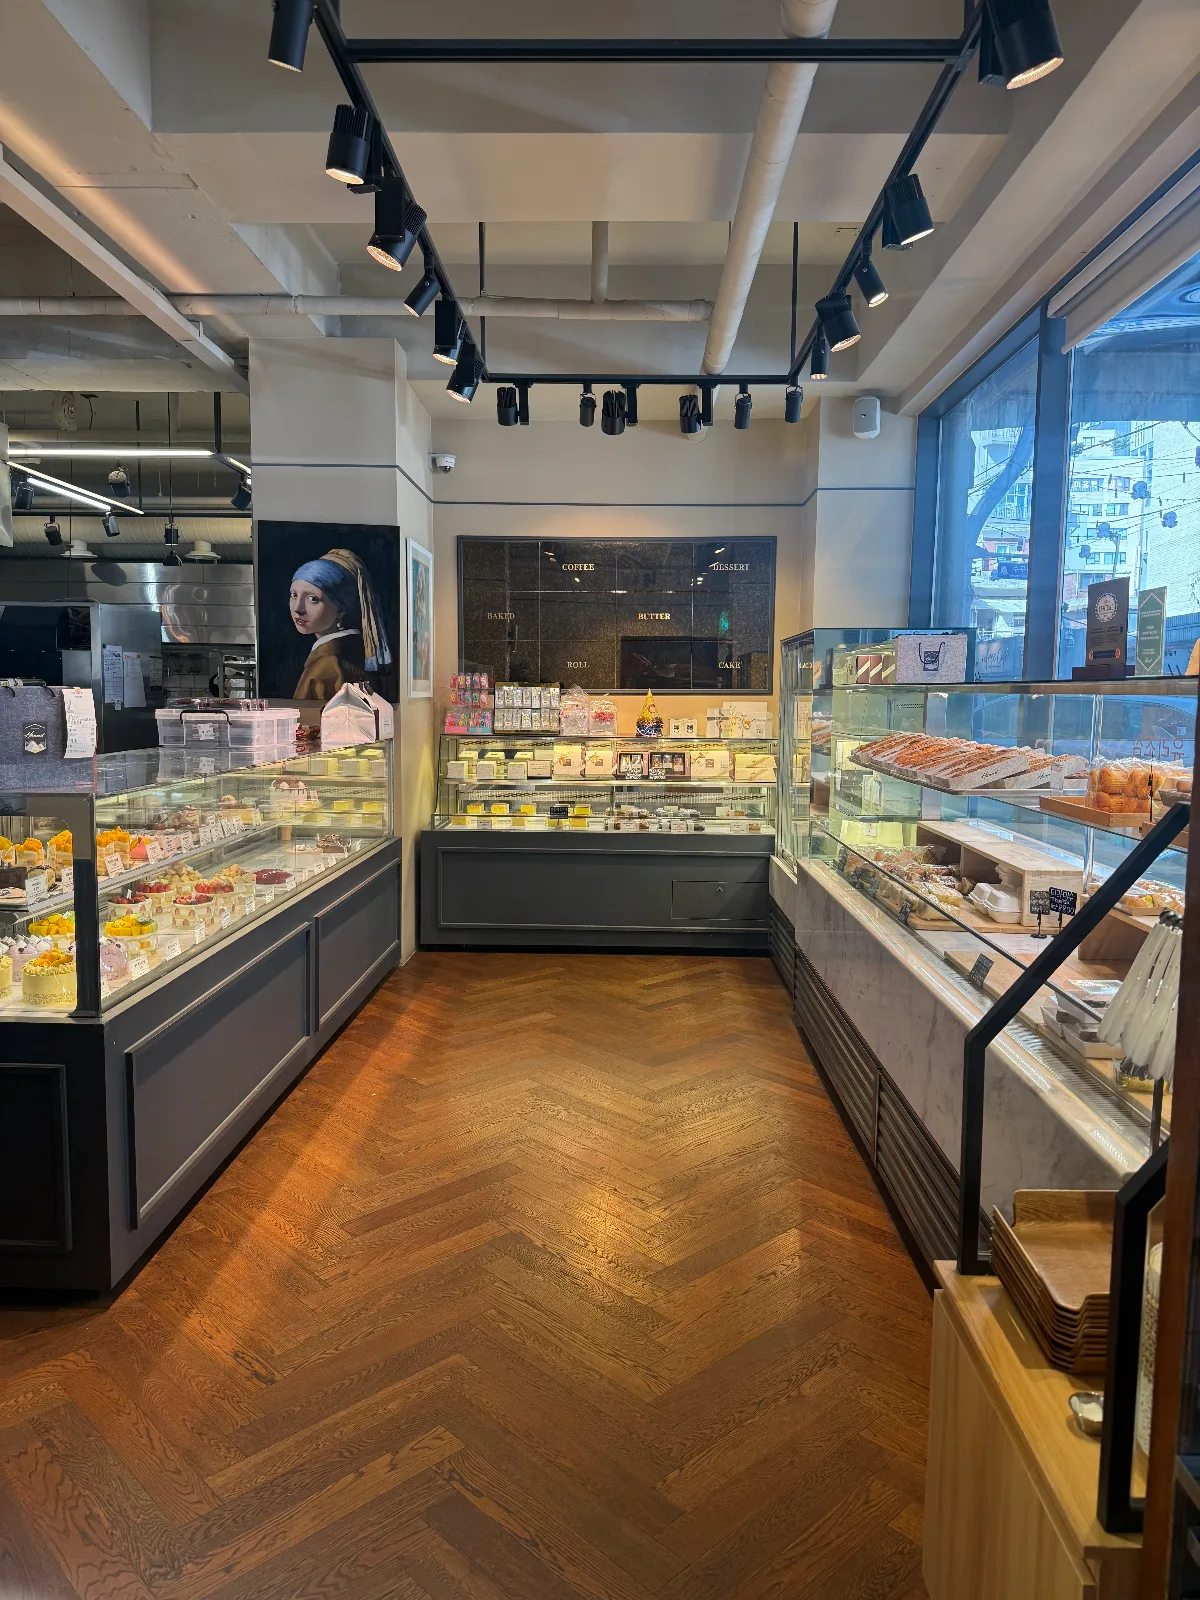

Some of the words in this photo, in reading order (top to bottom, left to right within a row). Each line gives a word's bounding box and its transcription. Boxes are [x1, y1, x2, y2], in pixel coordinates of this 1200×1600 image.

[561, 563, 595, 571] COFFEE
[712, 563, 750, 571] DESSERT
[486, 612, 516, 621] BAKED
[637, 612, 671, 621] BUTTER
[566, 661, 590, 669] ROLL
[717, 661, 741, 669] CAKE
